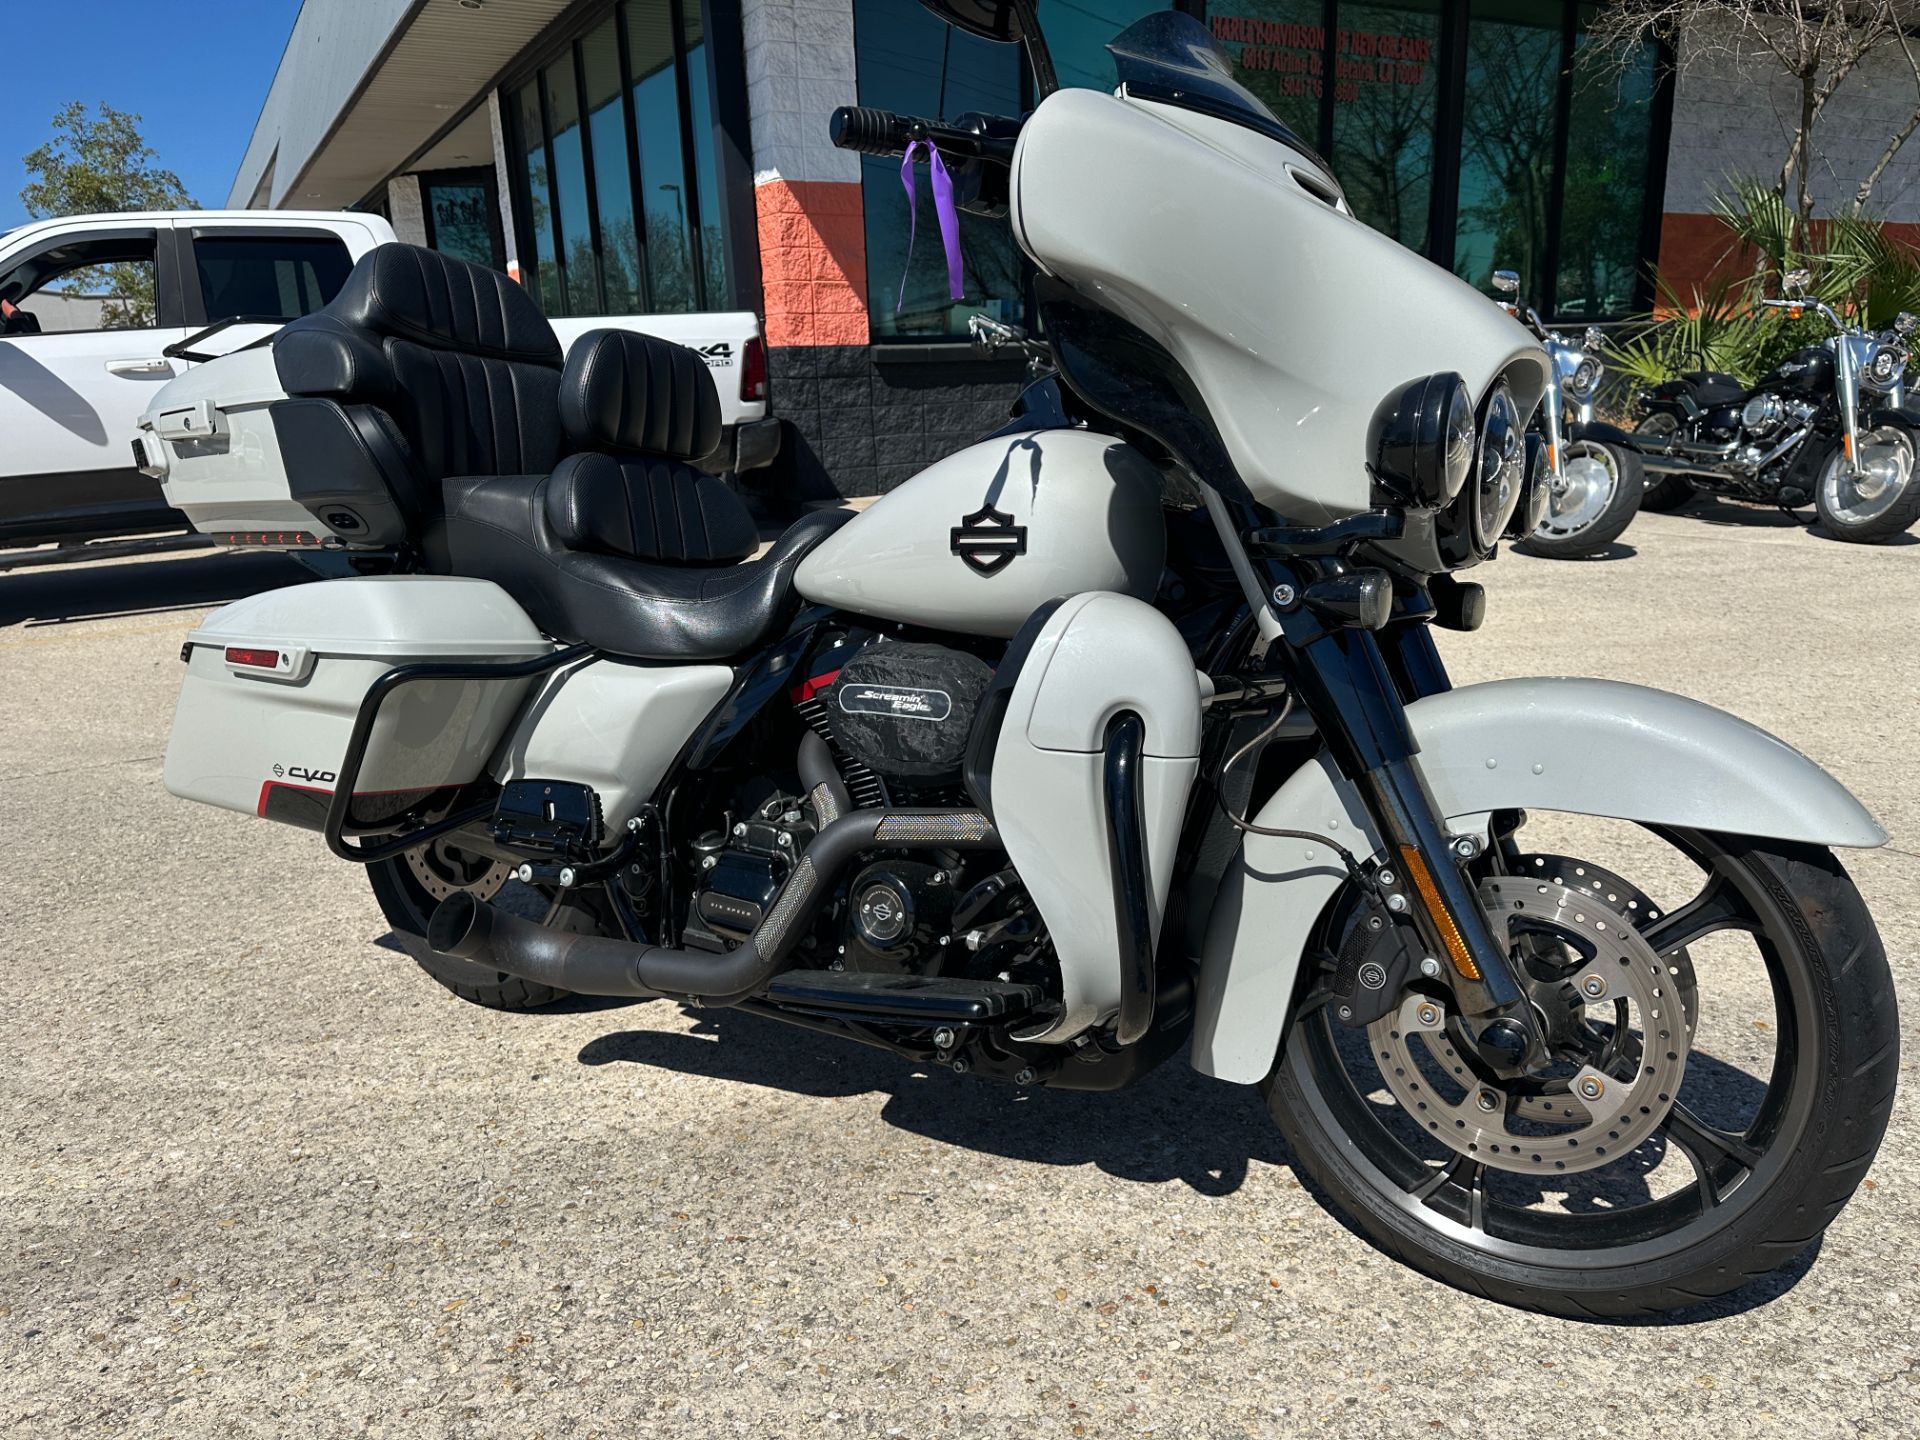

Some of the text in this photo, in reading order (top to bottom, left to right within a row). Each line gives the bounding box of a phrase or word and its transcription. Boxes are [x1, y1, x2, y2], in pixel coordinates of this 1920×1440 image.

[1212, 17, 1325, 49] HARLEY-DAVIDSON
[1352, 33, 1377, 56] NEW
[1379, 36, 1429, 61] ORLEANS
[1243, 48, 1270, 70] 6015
[1273, 51, 1307, 73] Airline
[892, 701, 932, 711] Eagle
[288, 767, 336, 782] CVO
